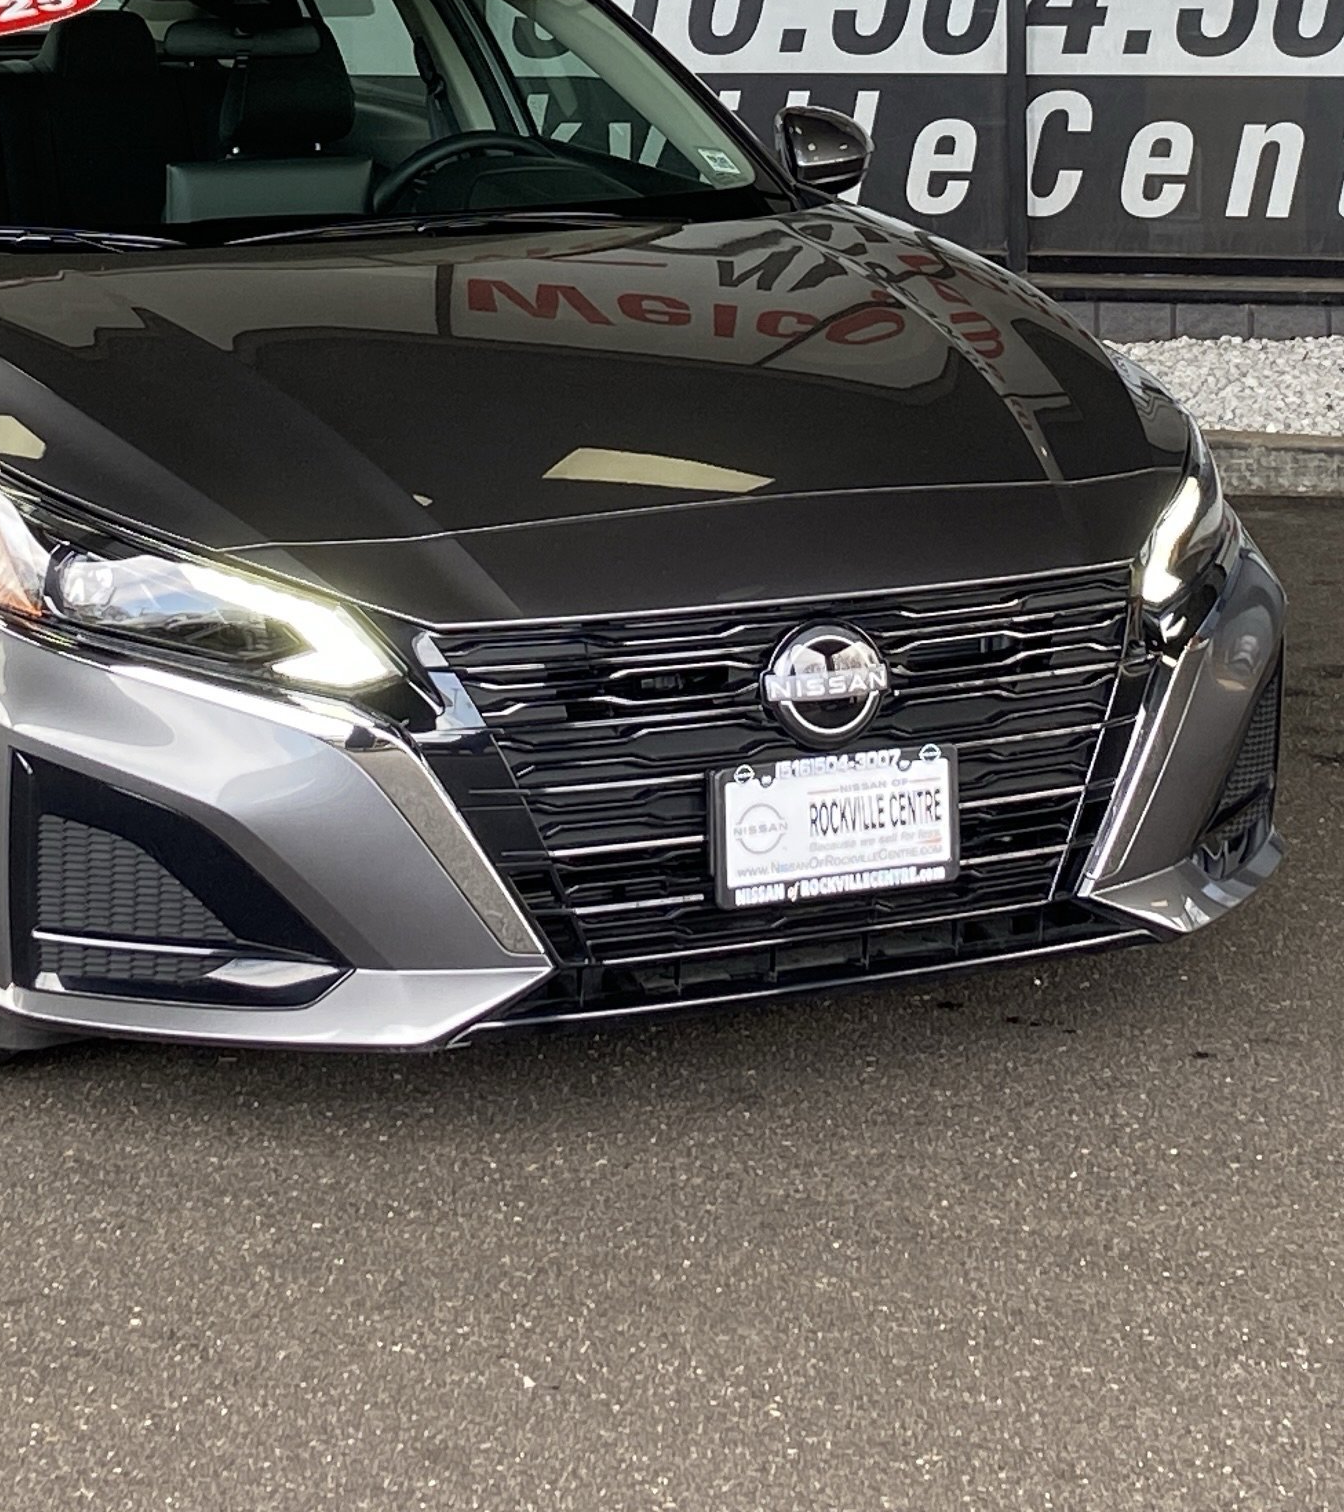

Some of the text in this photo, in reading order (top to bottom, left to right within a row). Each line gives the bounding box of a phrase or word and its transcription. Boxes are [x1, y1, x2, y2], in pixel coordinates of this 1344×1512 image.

[769, 668, 888, 699] NISSAN
[839, 777, 909, 793] NISSAN OF
[809, 788, 943, 837] ROCKVILLE CENTRE
[733, 821, 788, 836] NISSAN
